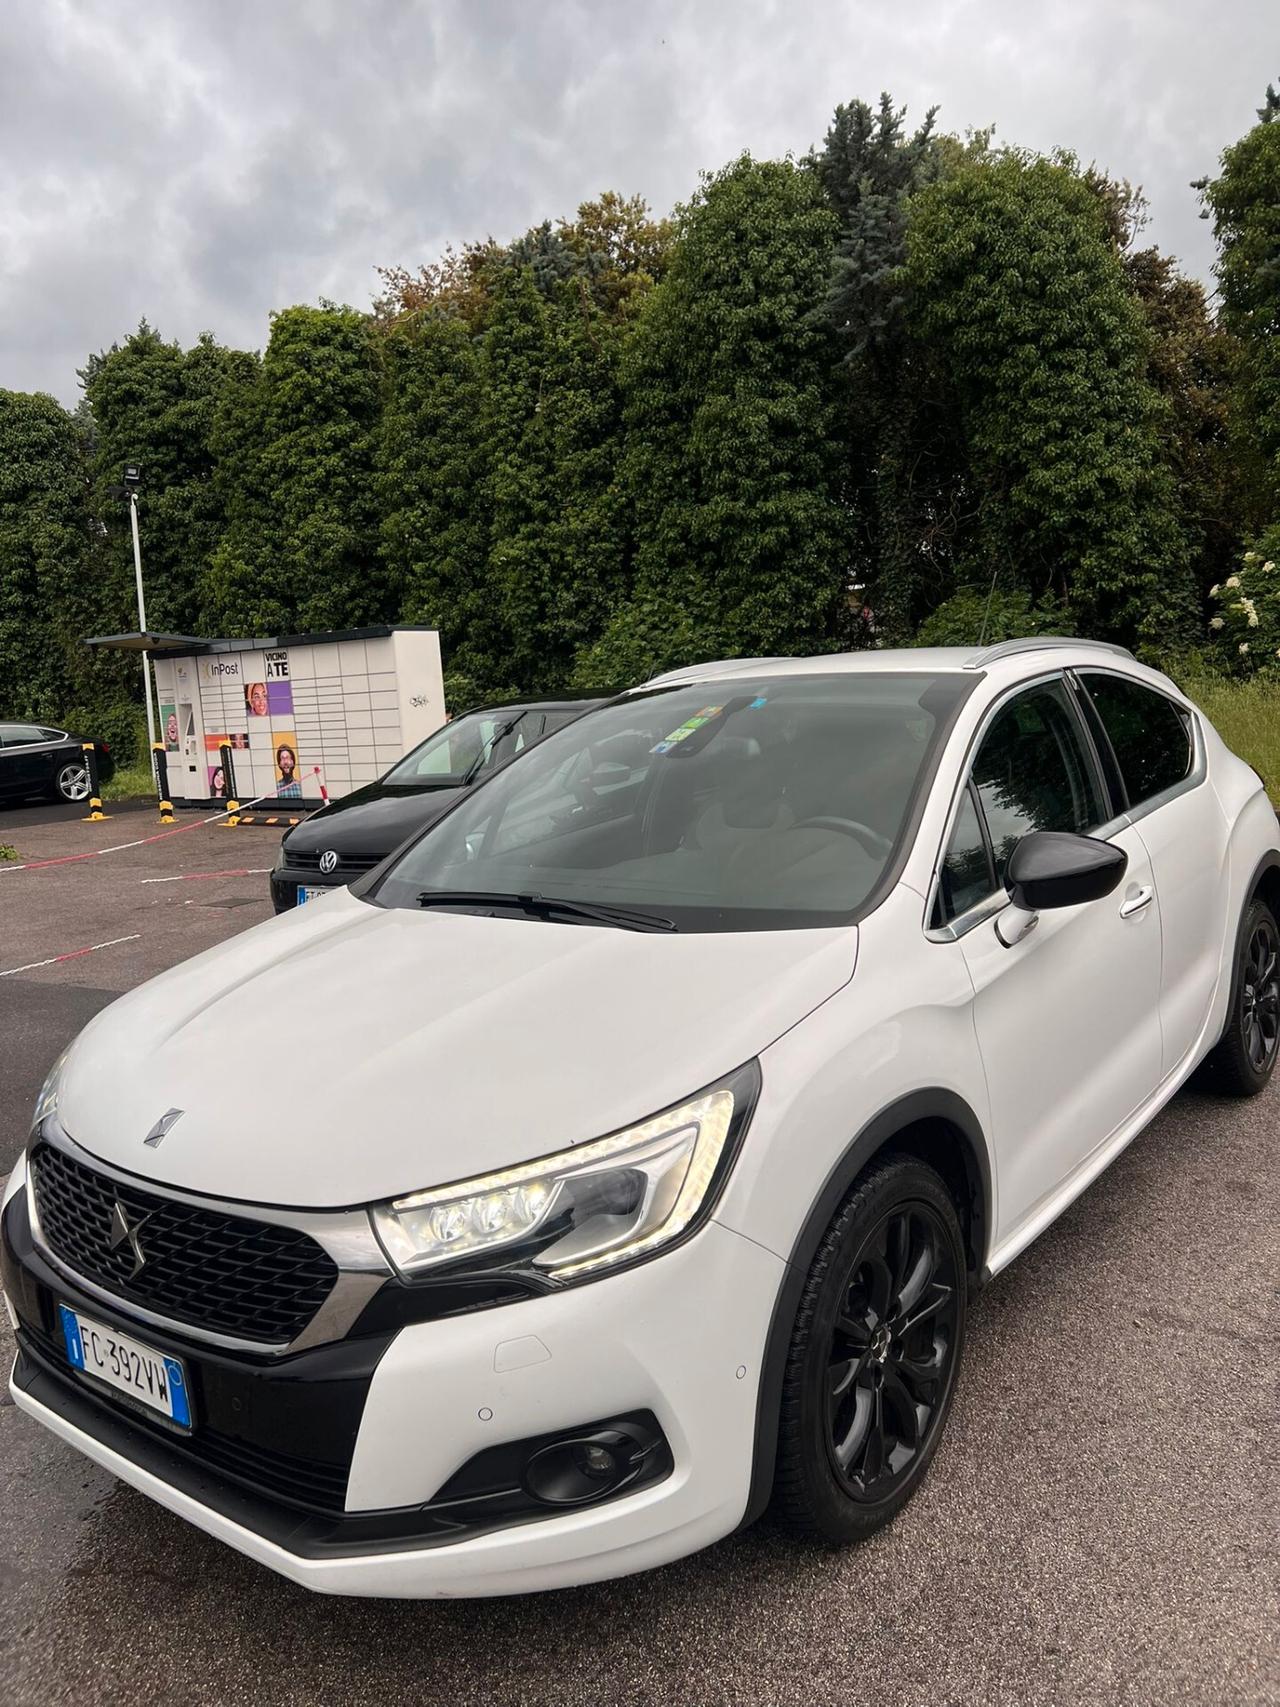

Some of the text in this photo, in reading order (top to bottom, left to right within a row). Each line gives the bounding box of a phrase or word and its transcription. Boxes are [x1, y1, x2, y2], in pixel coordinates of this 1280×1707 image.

[265, 652, 287, 661] VICINO
[211, 662, 239, 676] InPost
[267, 662, 289, 677] A TE
